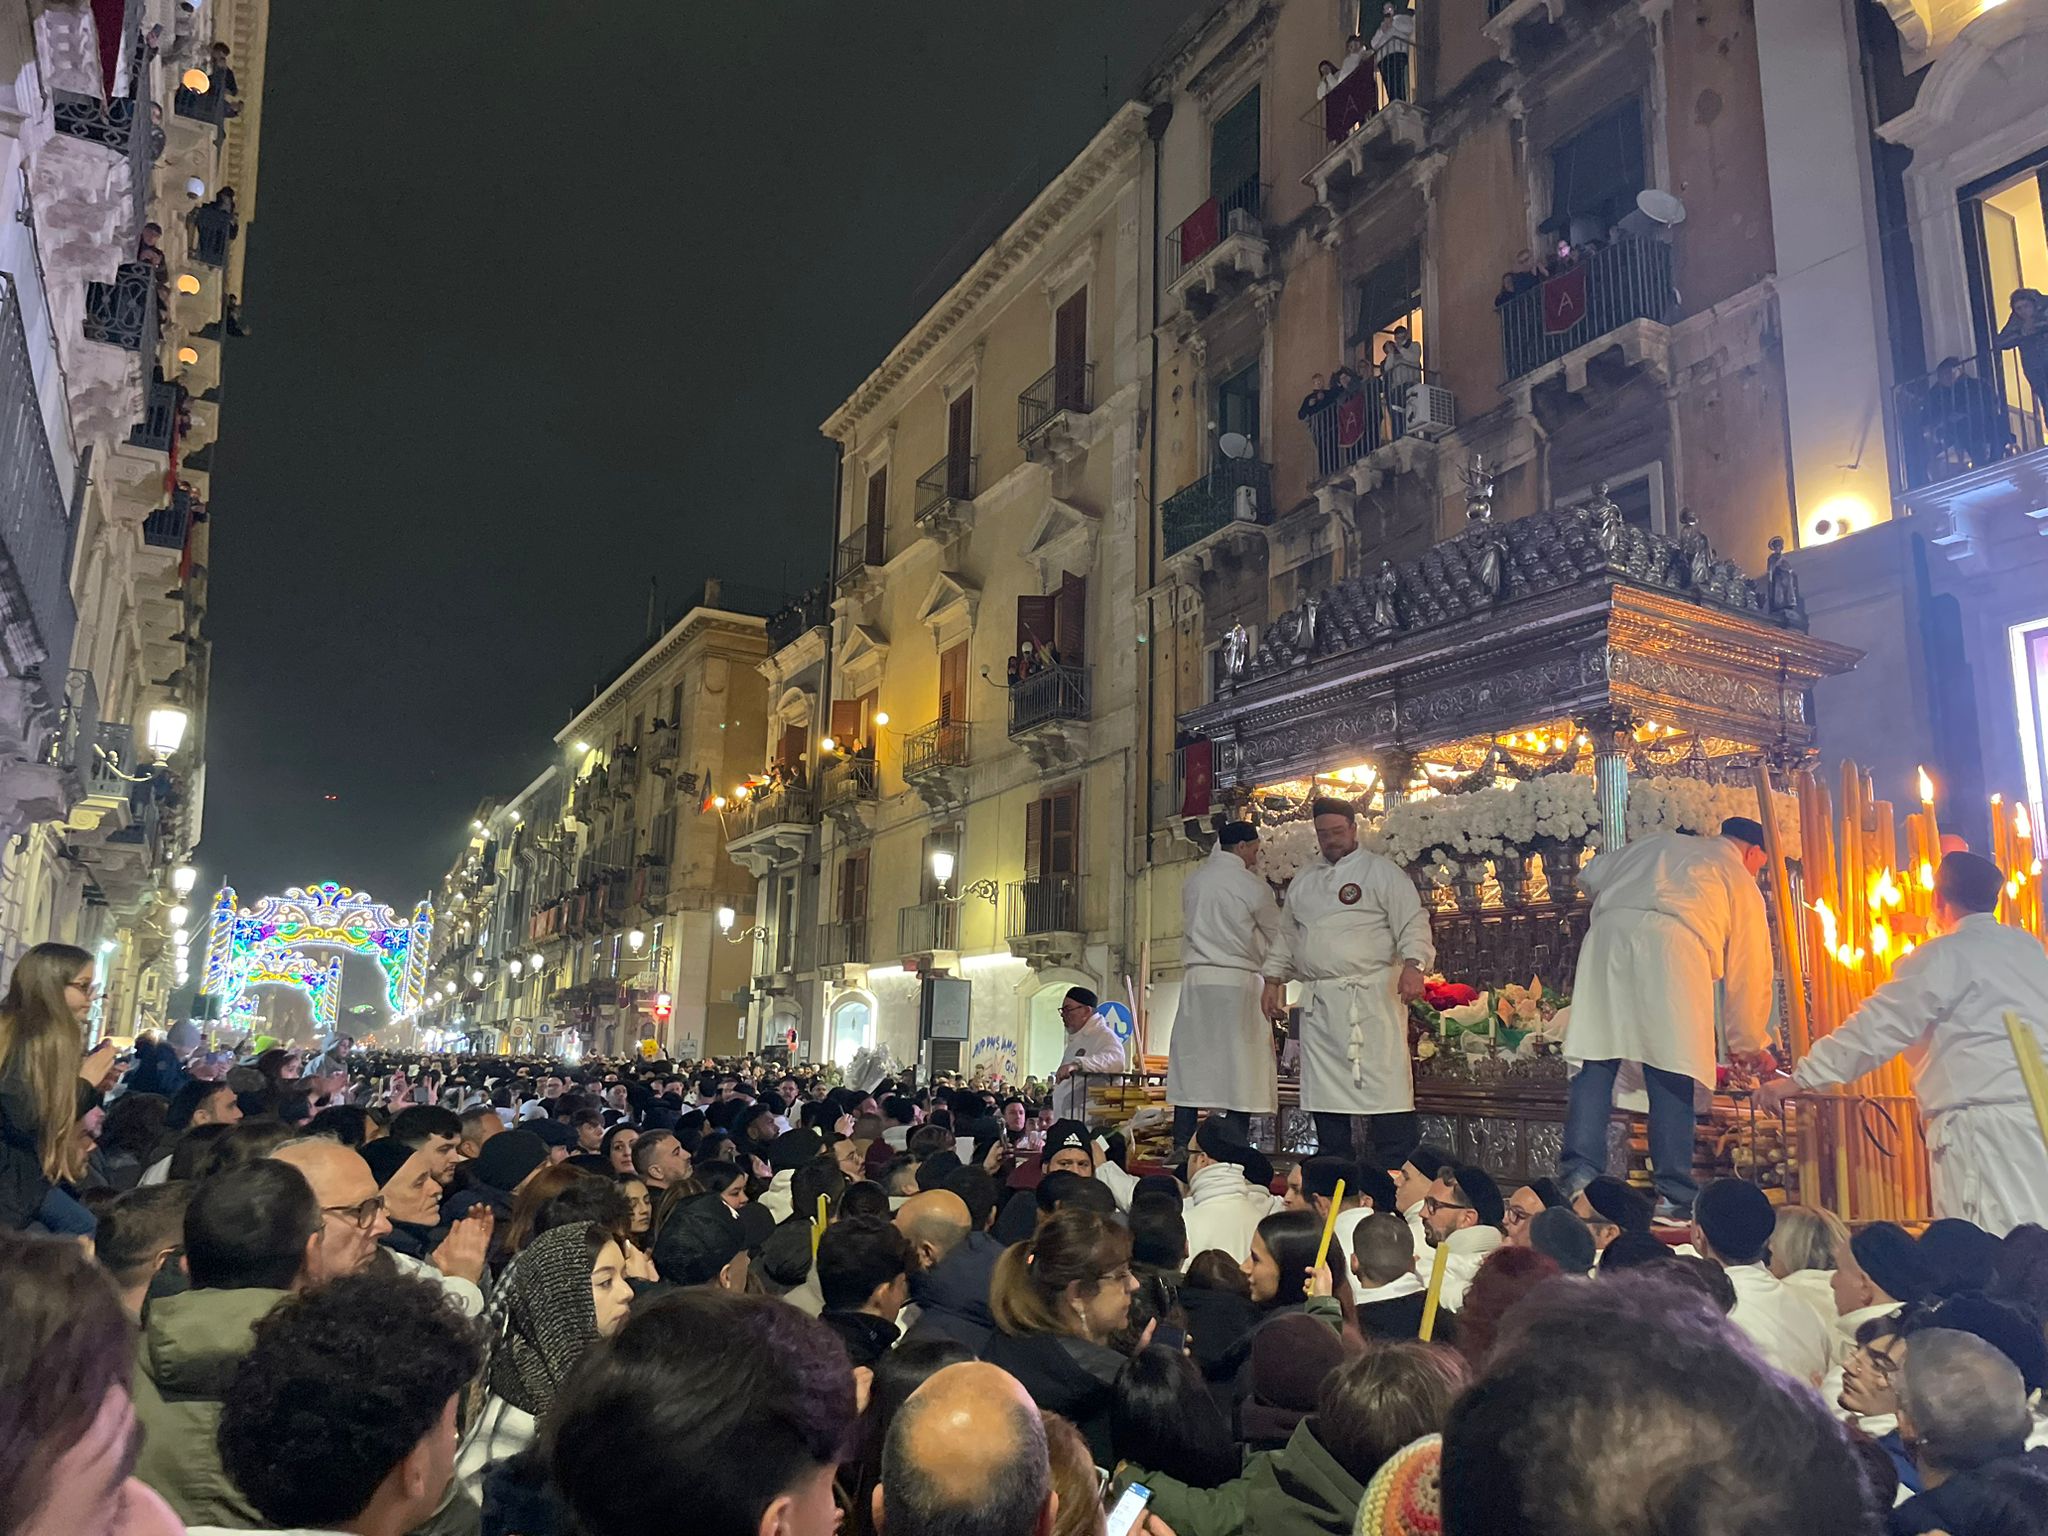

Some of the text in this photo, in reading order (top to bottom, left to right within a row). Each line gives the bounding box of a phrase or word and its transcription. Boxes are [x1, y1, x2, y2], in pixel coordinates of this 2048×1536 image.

[1342, 93, 1360, 124] A
[1558, 291, 1574, 317] A
[1345, 411, 1358, 433] A
